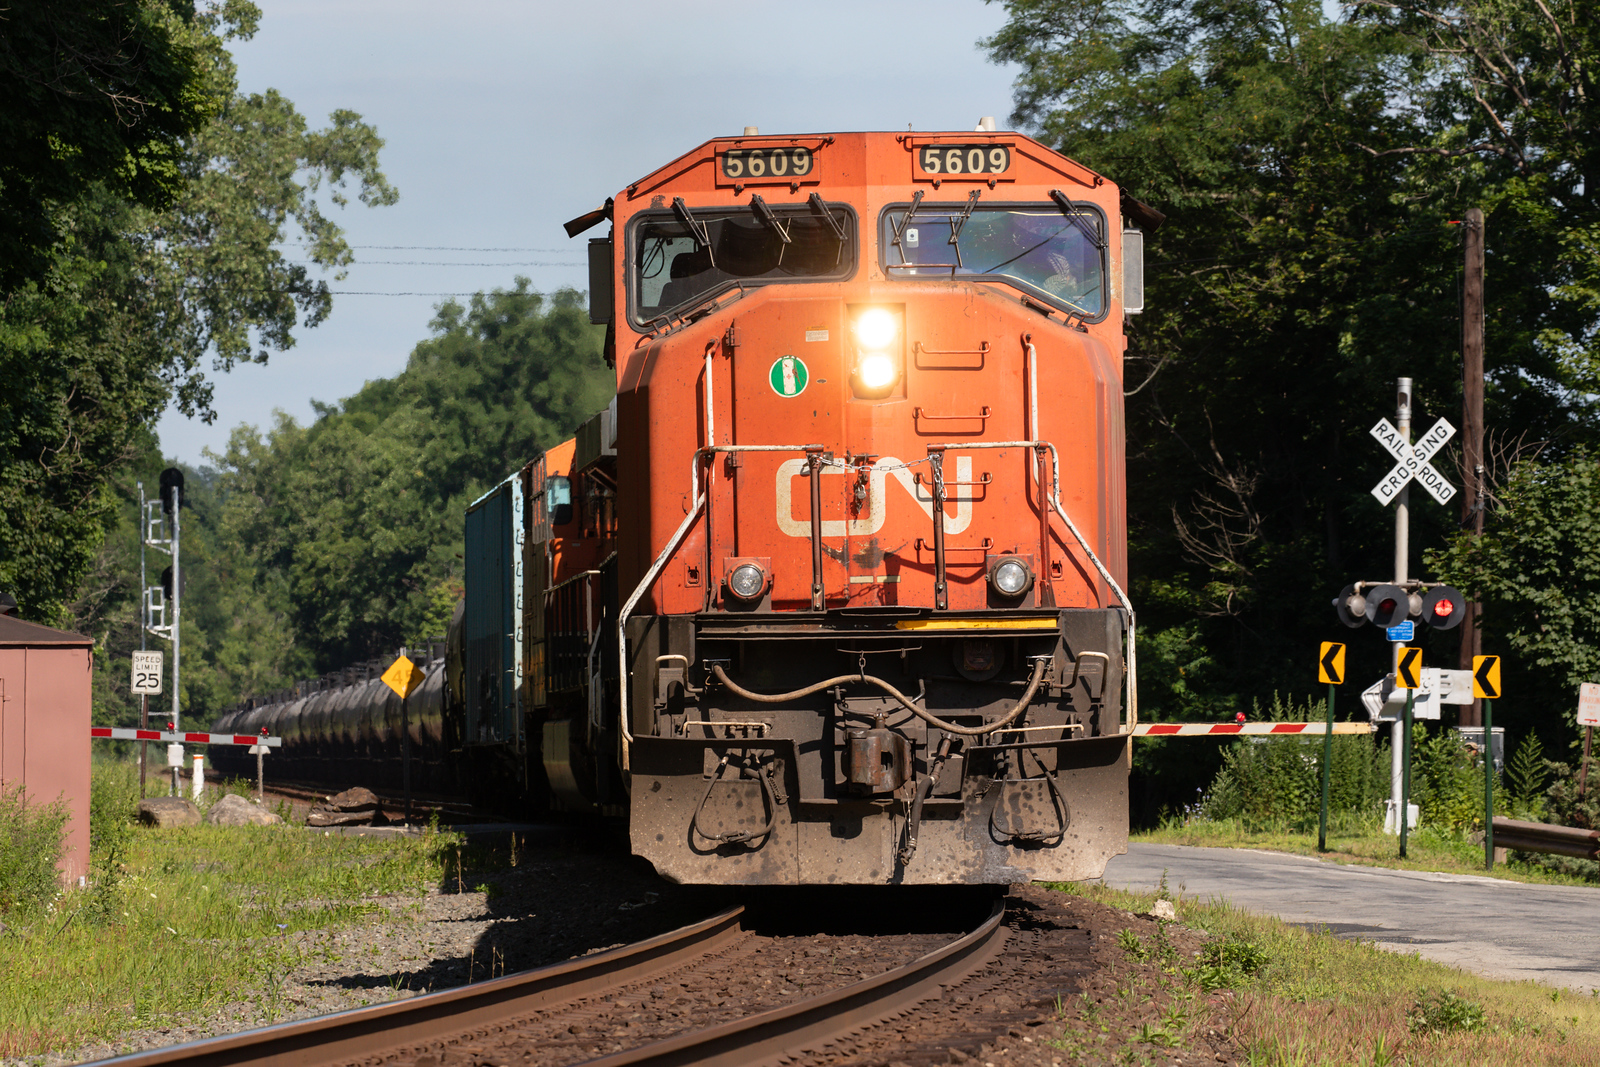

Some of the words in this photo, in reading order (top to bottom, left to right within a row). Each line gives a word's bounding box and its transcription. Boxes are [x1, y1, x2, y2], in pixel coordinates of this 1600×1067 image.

[726, 148, 810, 177] 5609
[924, 149, 1007, 174] 5609
[1375, 423, 1405, 458] RAIL
[1380, 425, 1448, 497] CROSSING
[776, 456, 972, 537] CN
[1418, 466, 1452, 500] ROAD
[135, 655, 161, 663] SPEED
[135, 672, 159, 688] 25
[391, 670, 415, 684] 45
